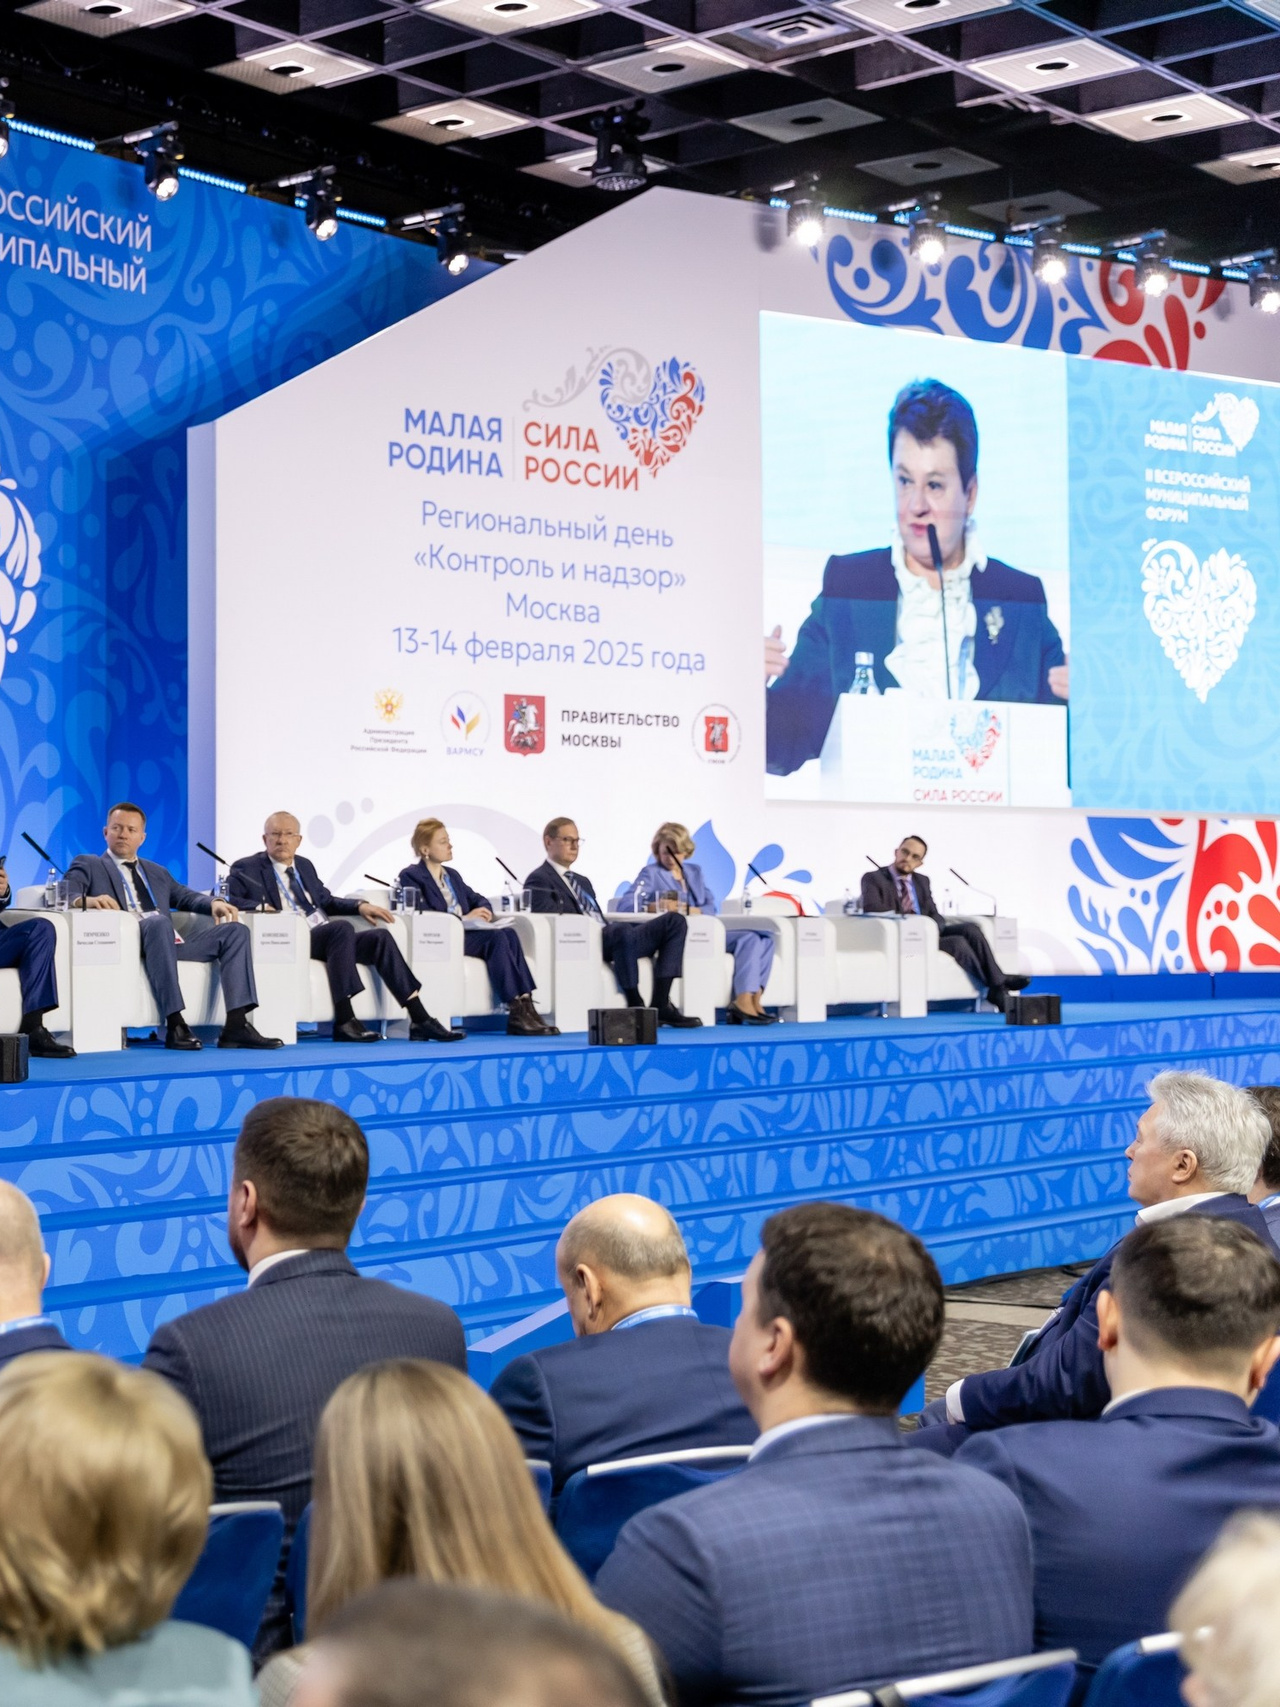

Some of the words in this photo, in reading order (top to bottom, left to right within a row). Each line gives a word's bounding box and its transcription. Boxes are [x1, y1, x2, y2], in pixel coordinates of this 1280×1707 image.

[404, 407, 503, 443] МАЛАЯ
[524, 421, 600, 454] СИЛА
[388, 441, 504, 479] РОДИНА
[524, 455, 640, 492] РОССИИ
[1154, 468, 1251, 494] ВСЕРОССИЙСКИЙ
[421, 500, 608, 543] Региональный
[614, 524, 674, 550] день
[1145, 505, 1189, 523] ФОРУМ
[414, 544, 554, 581] «Контроль
[562, 560, 576, 581] и
[584, 561, 686, 595] надзор»
[506, 592, 601, 624] Москва
[392, 626, 458, 656] 13-14
[464, 631, 576, 667] февраля
[583, 639, 645, 668] 2025
[651, 648, 706, 676] года
[561, 709, 680, 728] ПРАВИТЕЛЬСТВО
[446, 746, 484, 757] ВАРМСУ
[561, 733, 622, 749] МОСКВЫ
[912, 749, 956, 761] МАЛАЯ
[913, 766, 963, 779] РОДИНА
[913, 788, 948, 801] СИЛА
[952, 790, 1003, 803] РОССИИ
